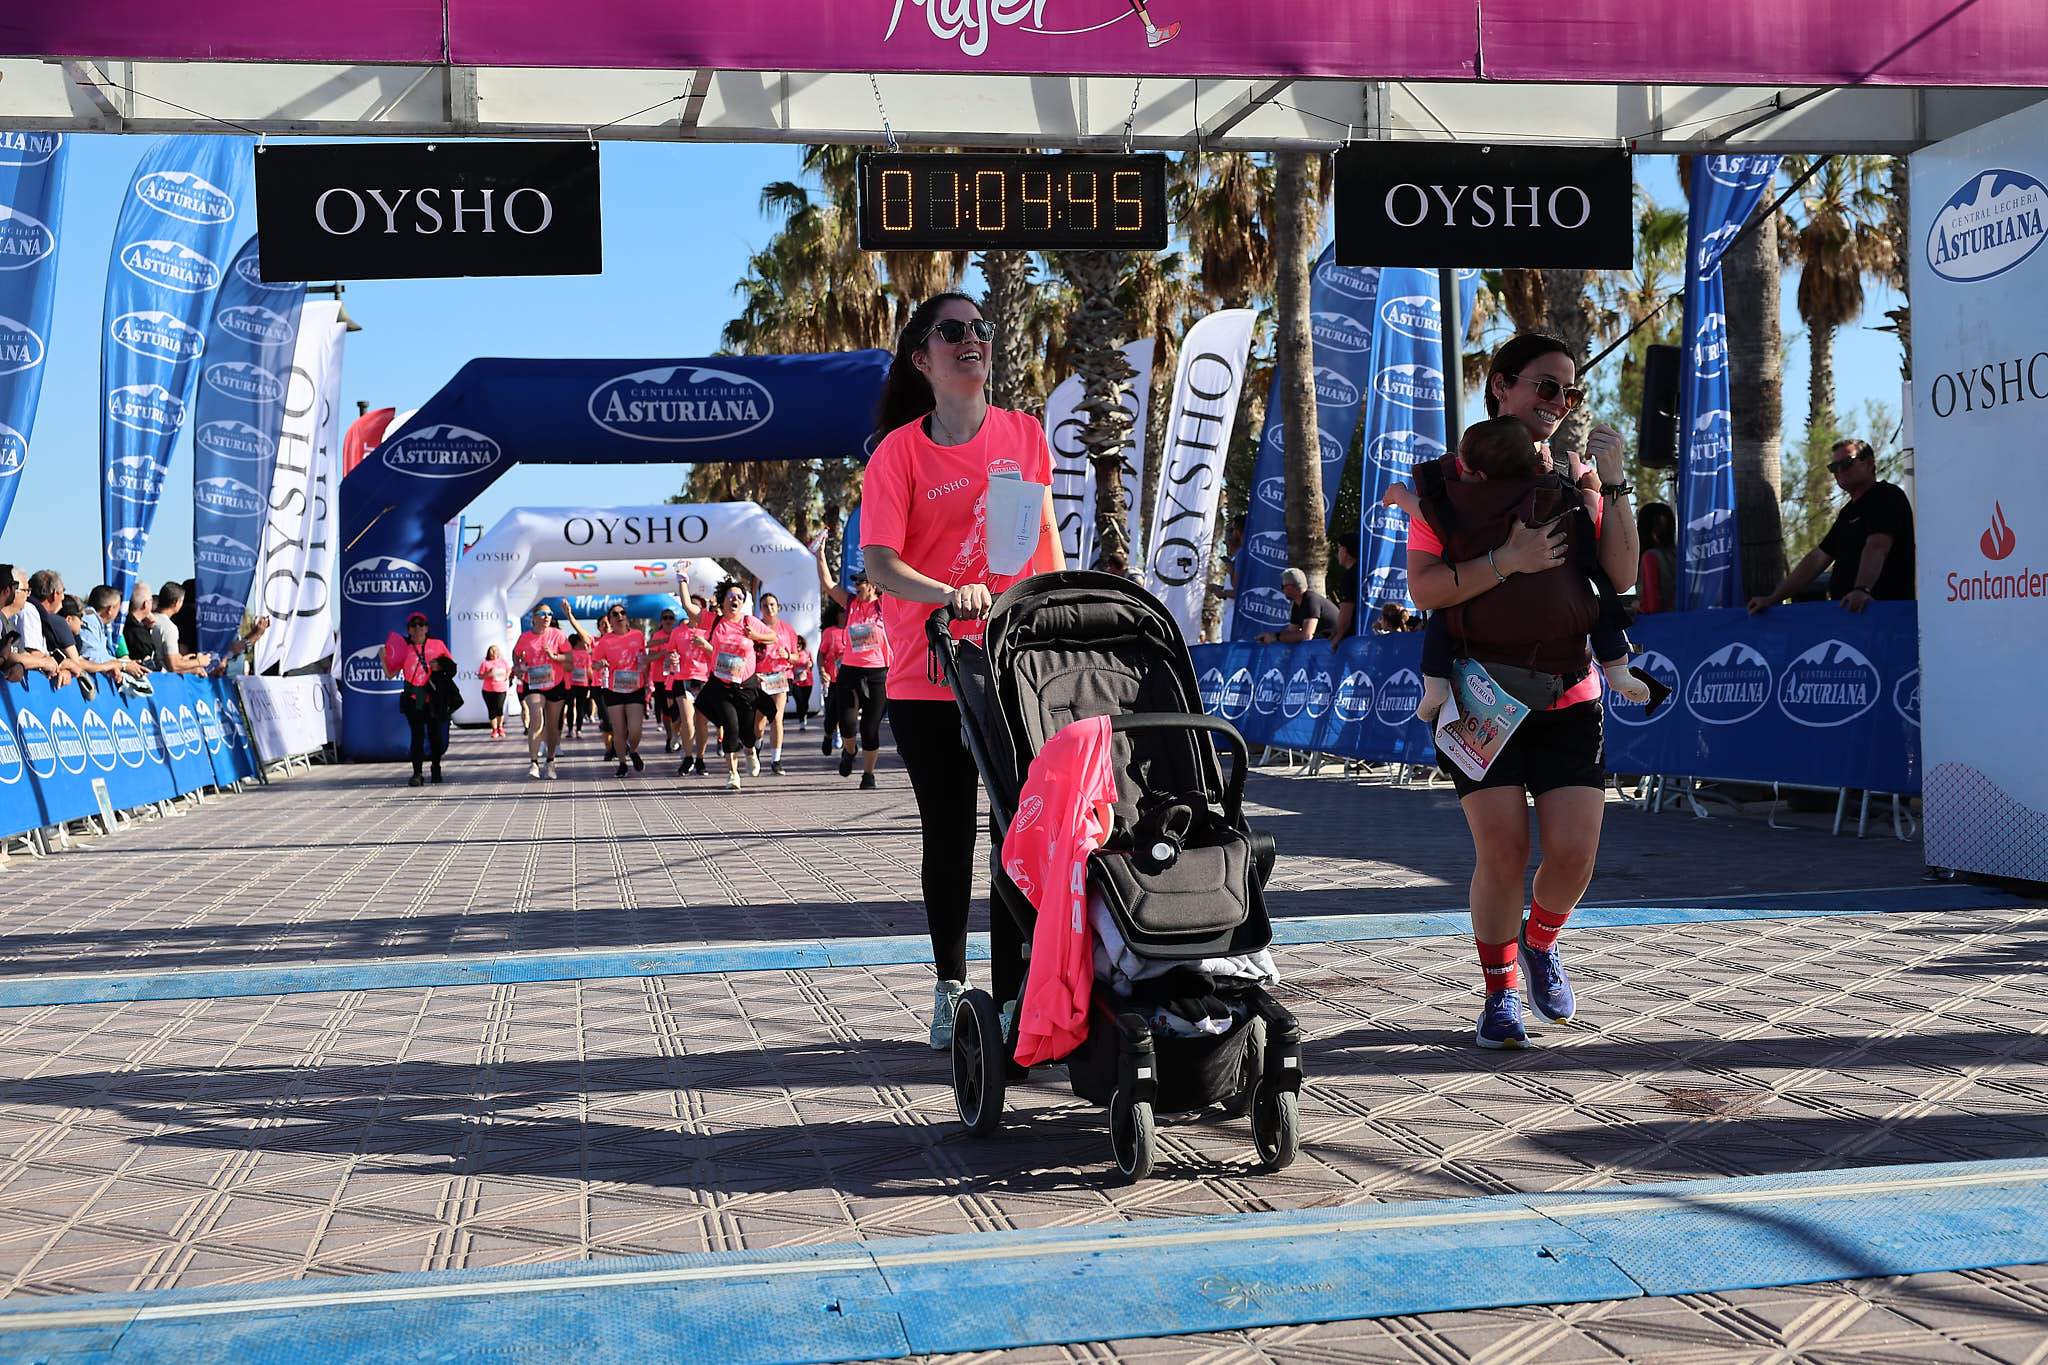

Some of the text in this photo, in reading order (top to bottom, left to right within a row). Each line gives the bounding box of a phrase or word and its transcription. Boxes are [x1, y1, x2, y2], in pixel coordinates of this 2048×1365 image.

[143, 180, 227, 218] ASTURIANA
[315, 187, 553, 235] OYSHO
[1385, 183, 1591, 229] OYSHO
[1951, 193, 2039, 229] CENTRAL LECHERA
[1935, 208, 2044, 266] ASTURIANA
[128, 248, 214, 286] ASTURIANA
[1321, 265, 1378, 294] ASTURIAN
[1312, 325, 1368, 349] STURIANA
[210, 369, 278, 398] ASTURIANA
[1380, 374, 1445, 402] ASTURIAN
[603, 390, 761, 423] ASTURIANA
[202, 428, 269, 456] ASTURIANA
[390, 446, 492, 465] ASTURIANA
[1154, 352, 1234, 587] OYSHO
[927, 477, 970, 500] OYSHO
[563, 515, 709, 546] OYSHO
[199, 550, 254, 568] STURIANA
[475, 551, 521, 562] OYSHO
[346, 576, 427, 595] ASTURIANA
[1690, 676, 1764, 704] ASTURIANA
[1783, 672, 1867, 705] ASTURIANA
